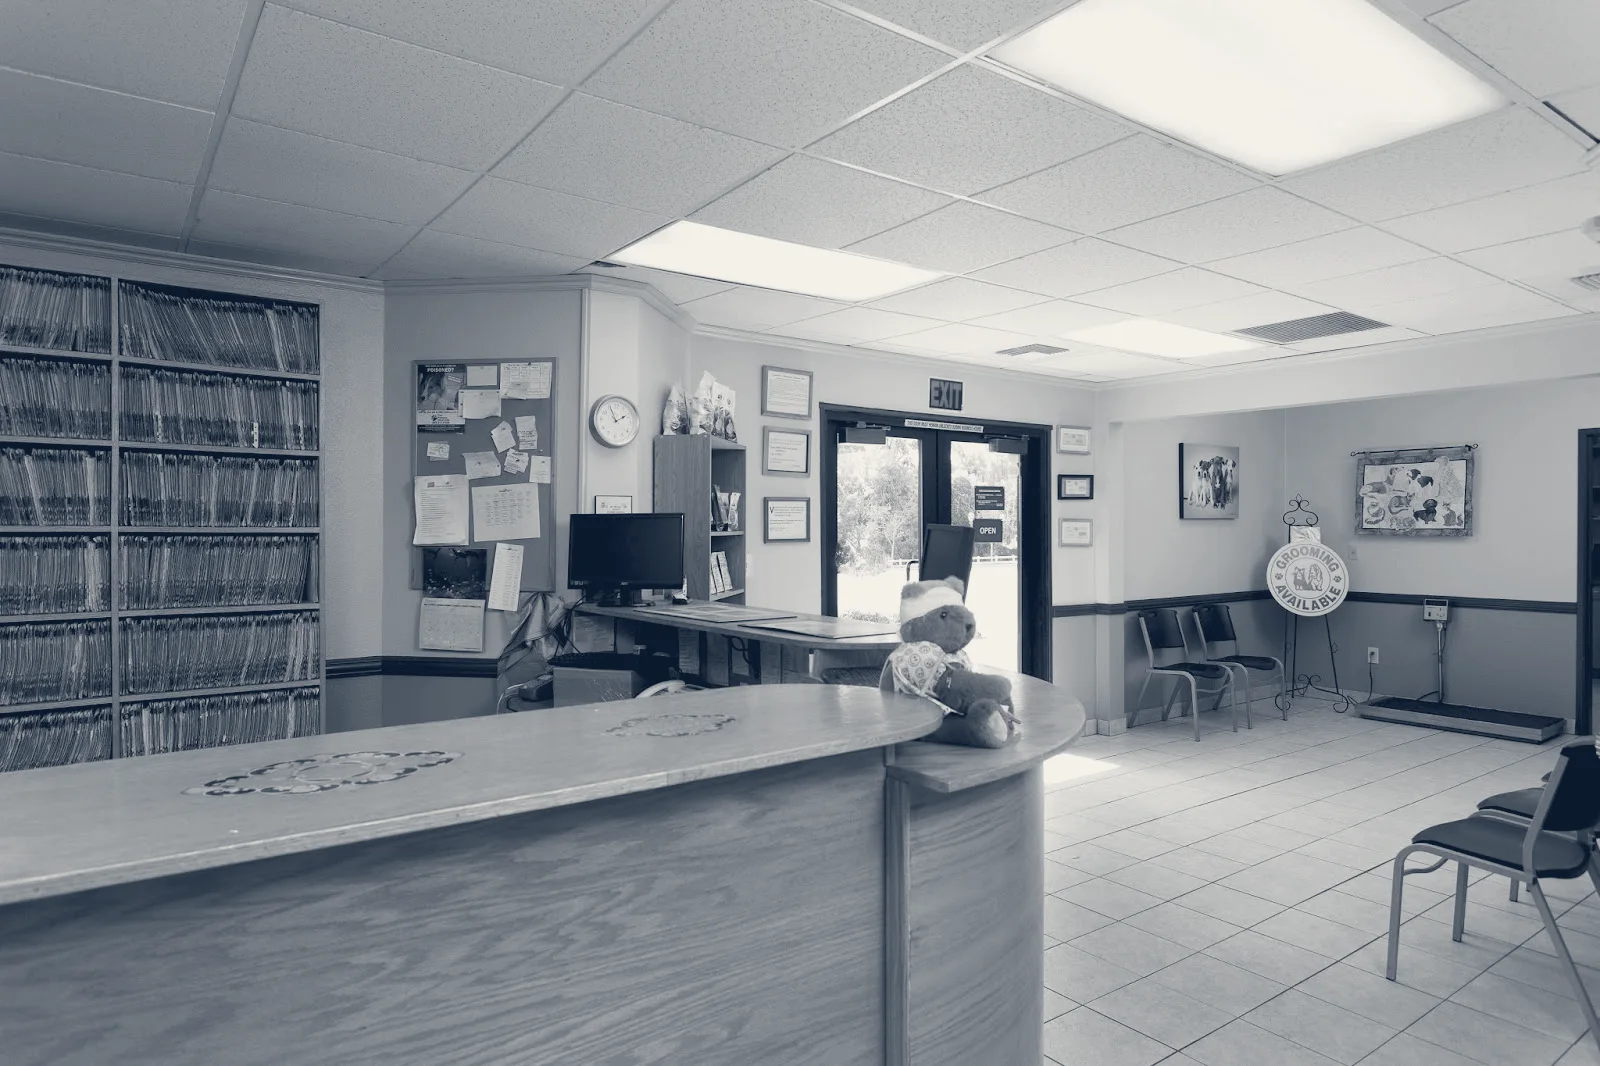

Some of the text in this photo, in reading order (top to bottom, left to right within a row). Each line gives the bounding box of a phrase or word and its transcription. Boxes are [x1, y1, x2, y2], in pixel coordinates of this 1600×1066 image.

[931, 380, 962, 409] EXIT
[979, 527, 997, 535] OPEN
[1275, 546, 1339, 572] GROOMING
[1275, 585, 1342, 611] AVAILABLE
